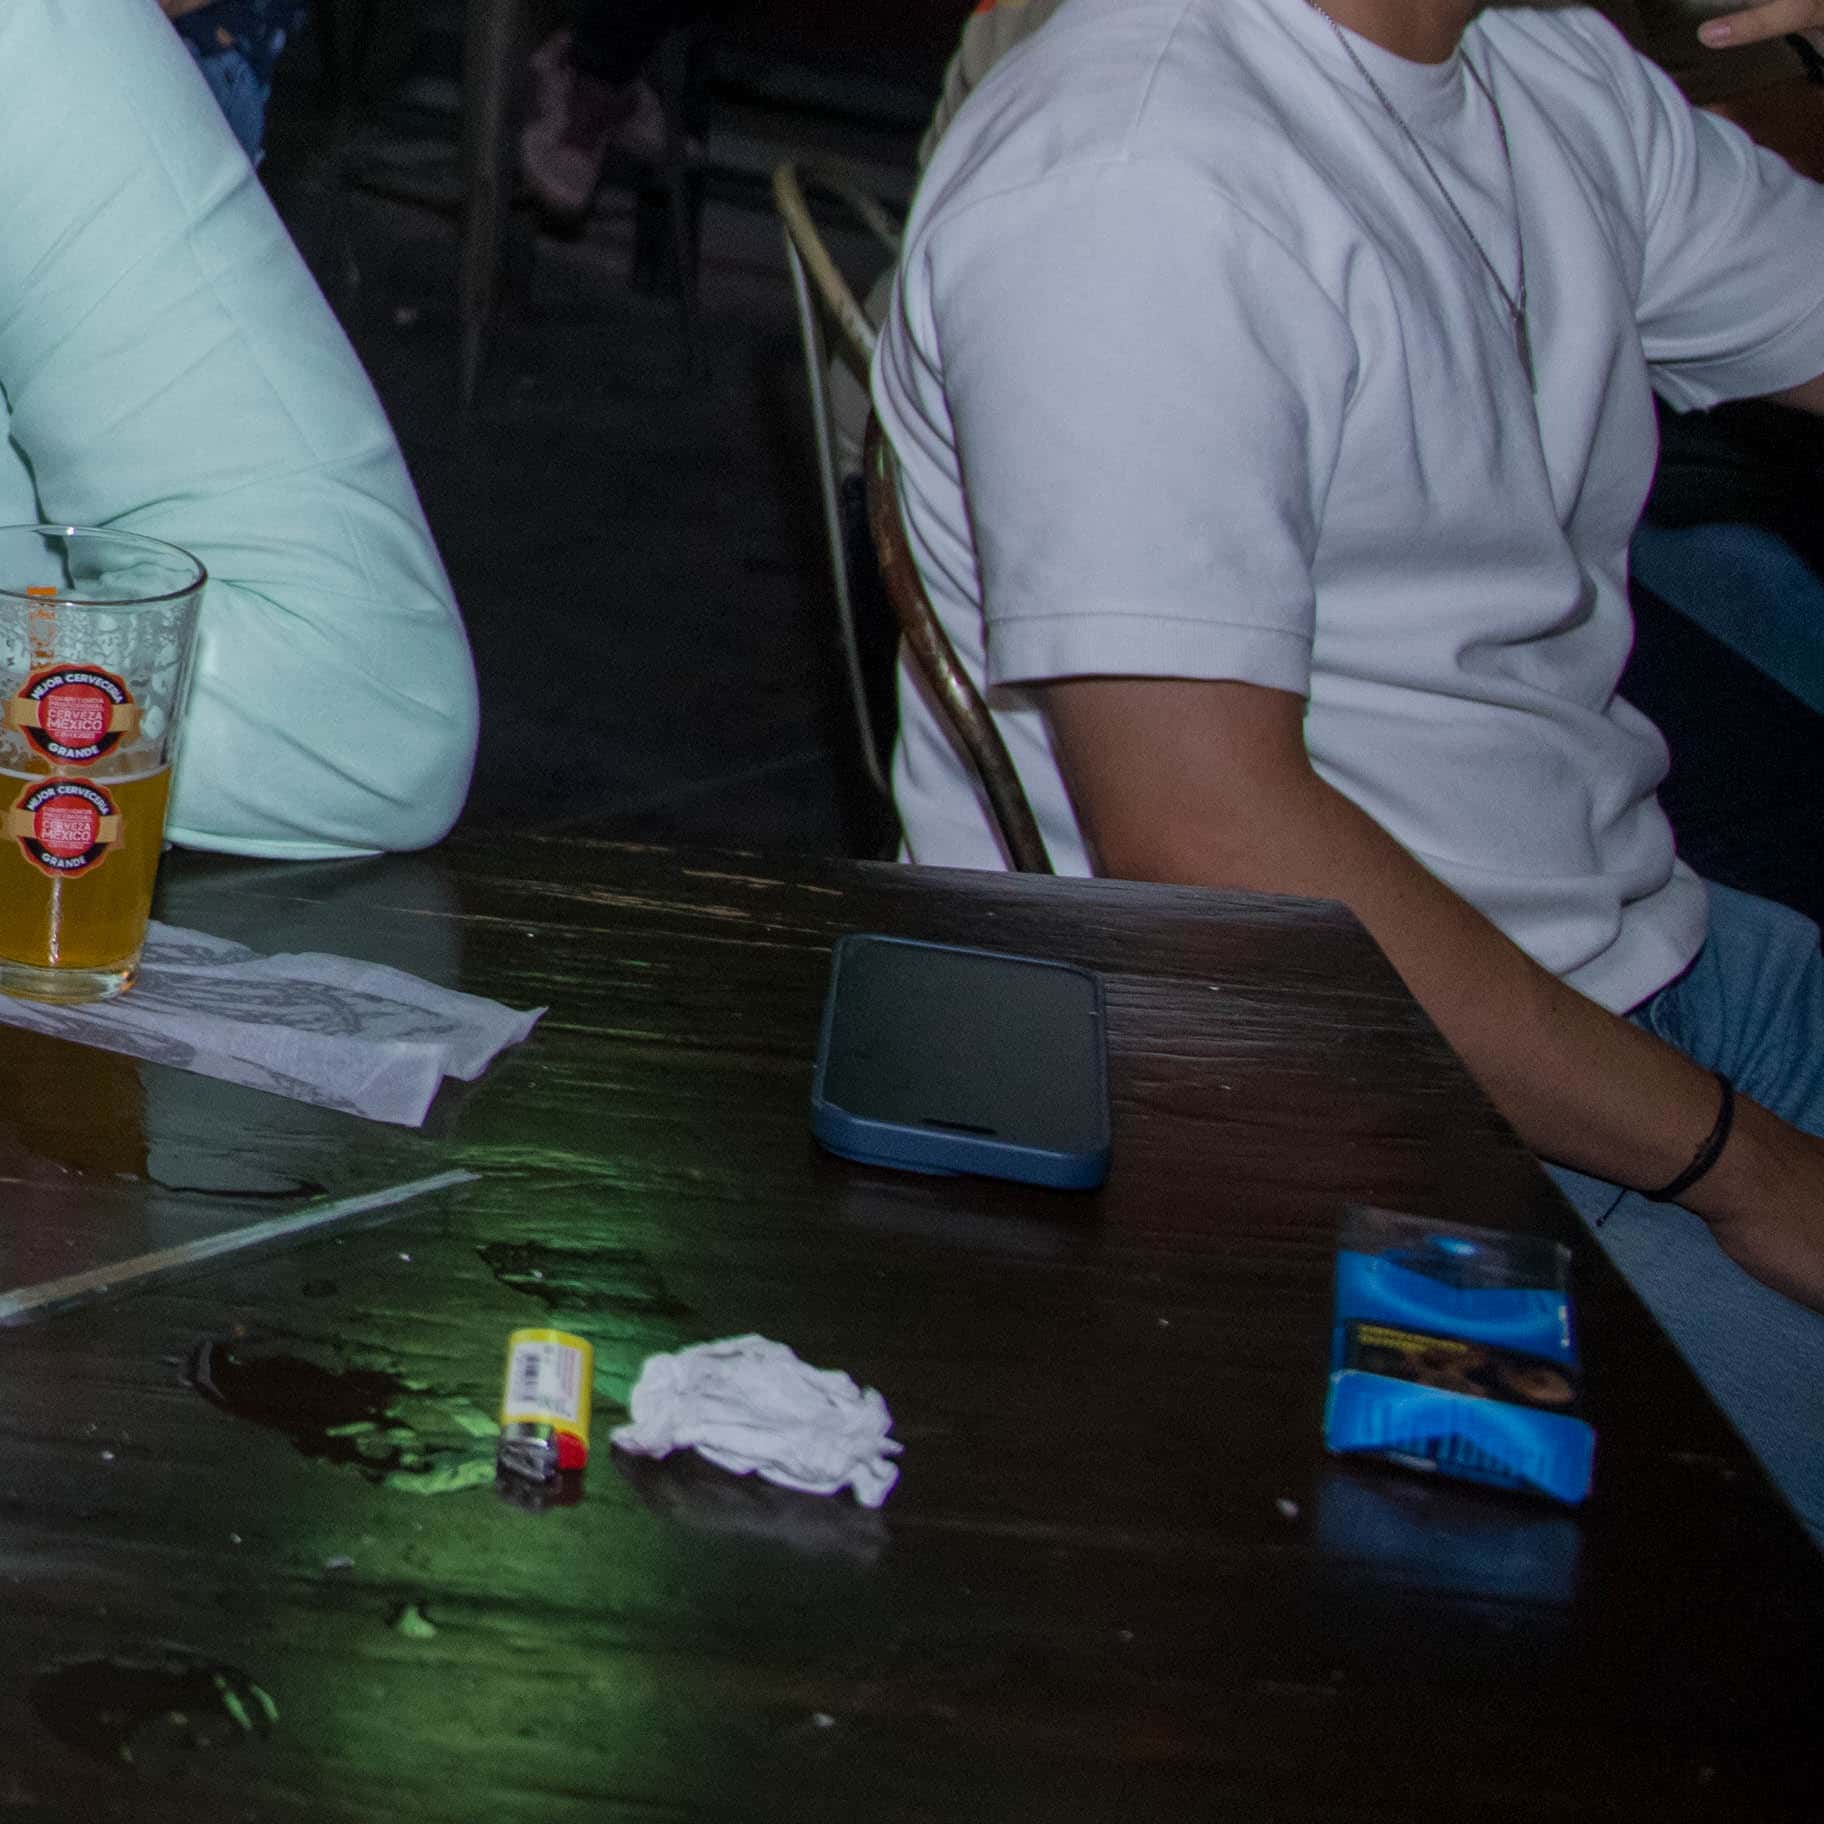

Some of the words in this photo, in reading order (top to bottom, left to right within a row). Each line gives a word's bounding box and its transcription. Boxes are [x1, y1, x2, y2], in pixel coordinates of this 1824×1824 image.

[31, 676, 64, 700] MEJOR
[48, 709, 103, 721] CERVEZA
[48, 743, 100, 758] GRANDE
[26, 788, 55, 811] MEJOR
[42, 852, 86, 867] GRANDE
